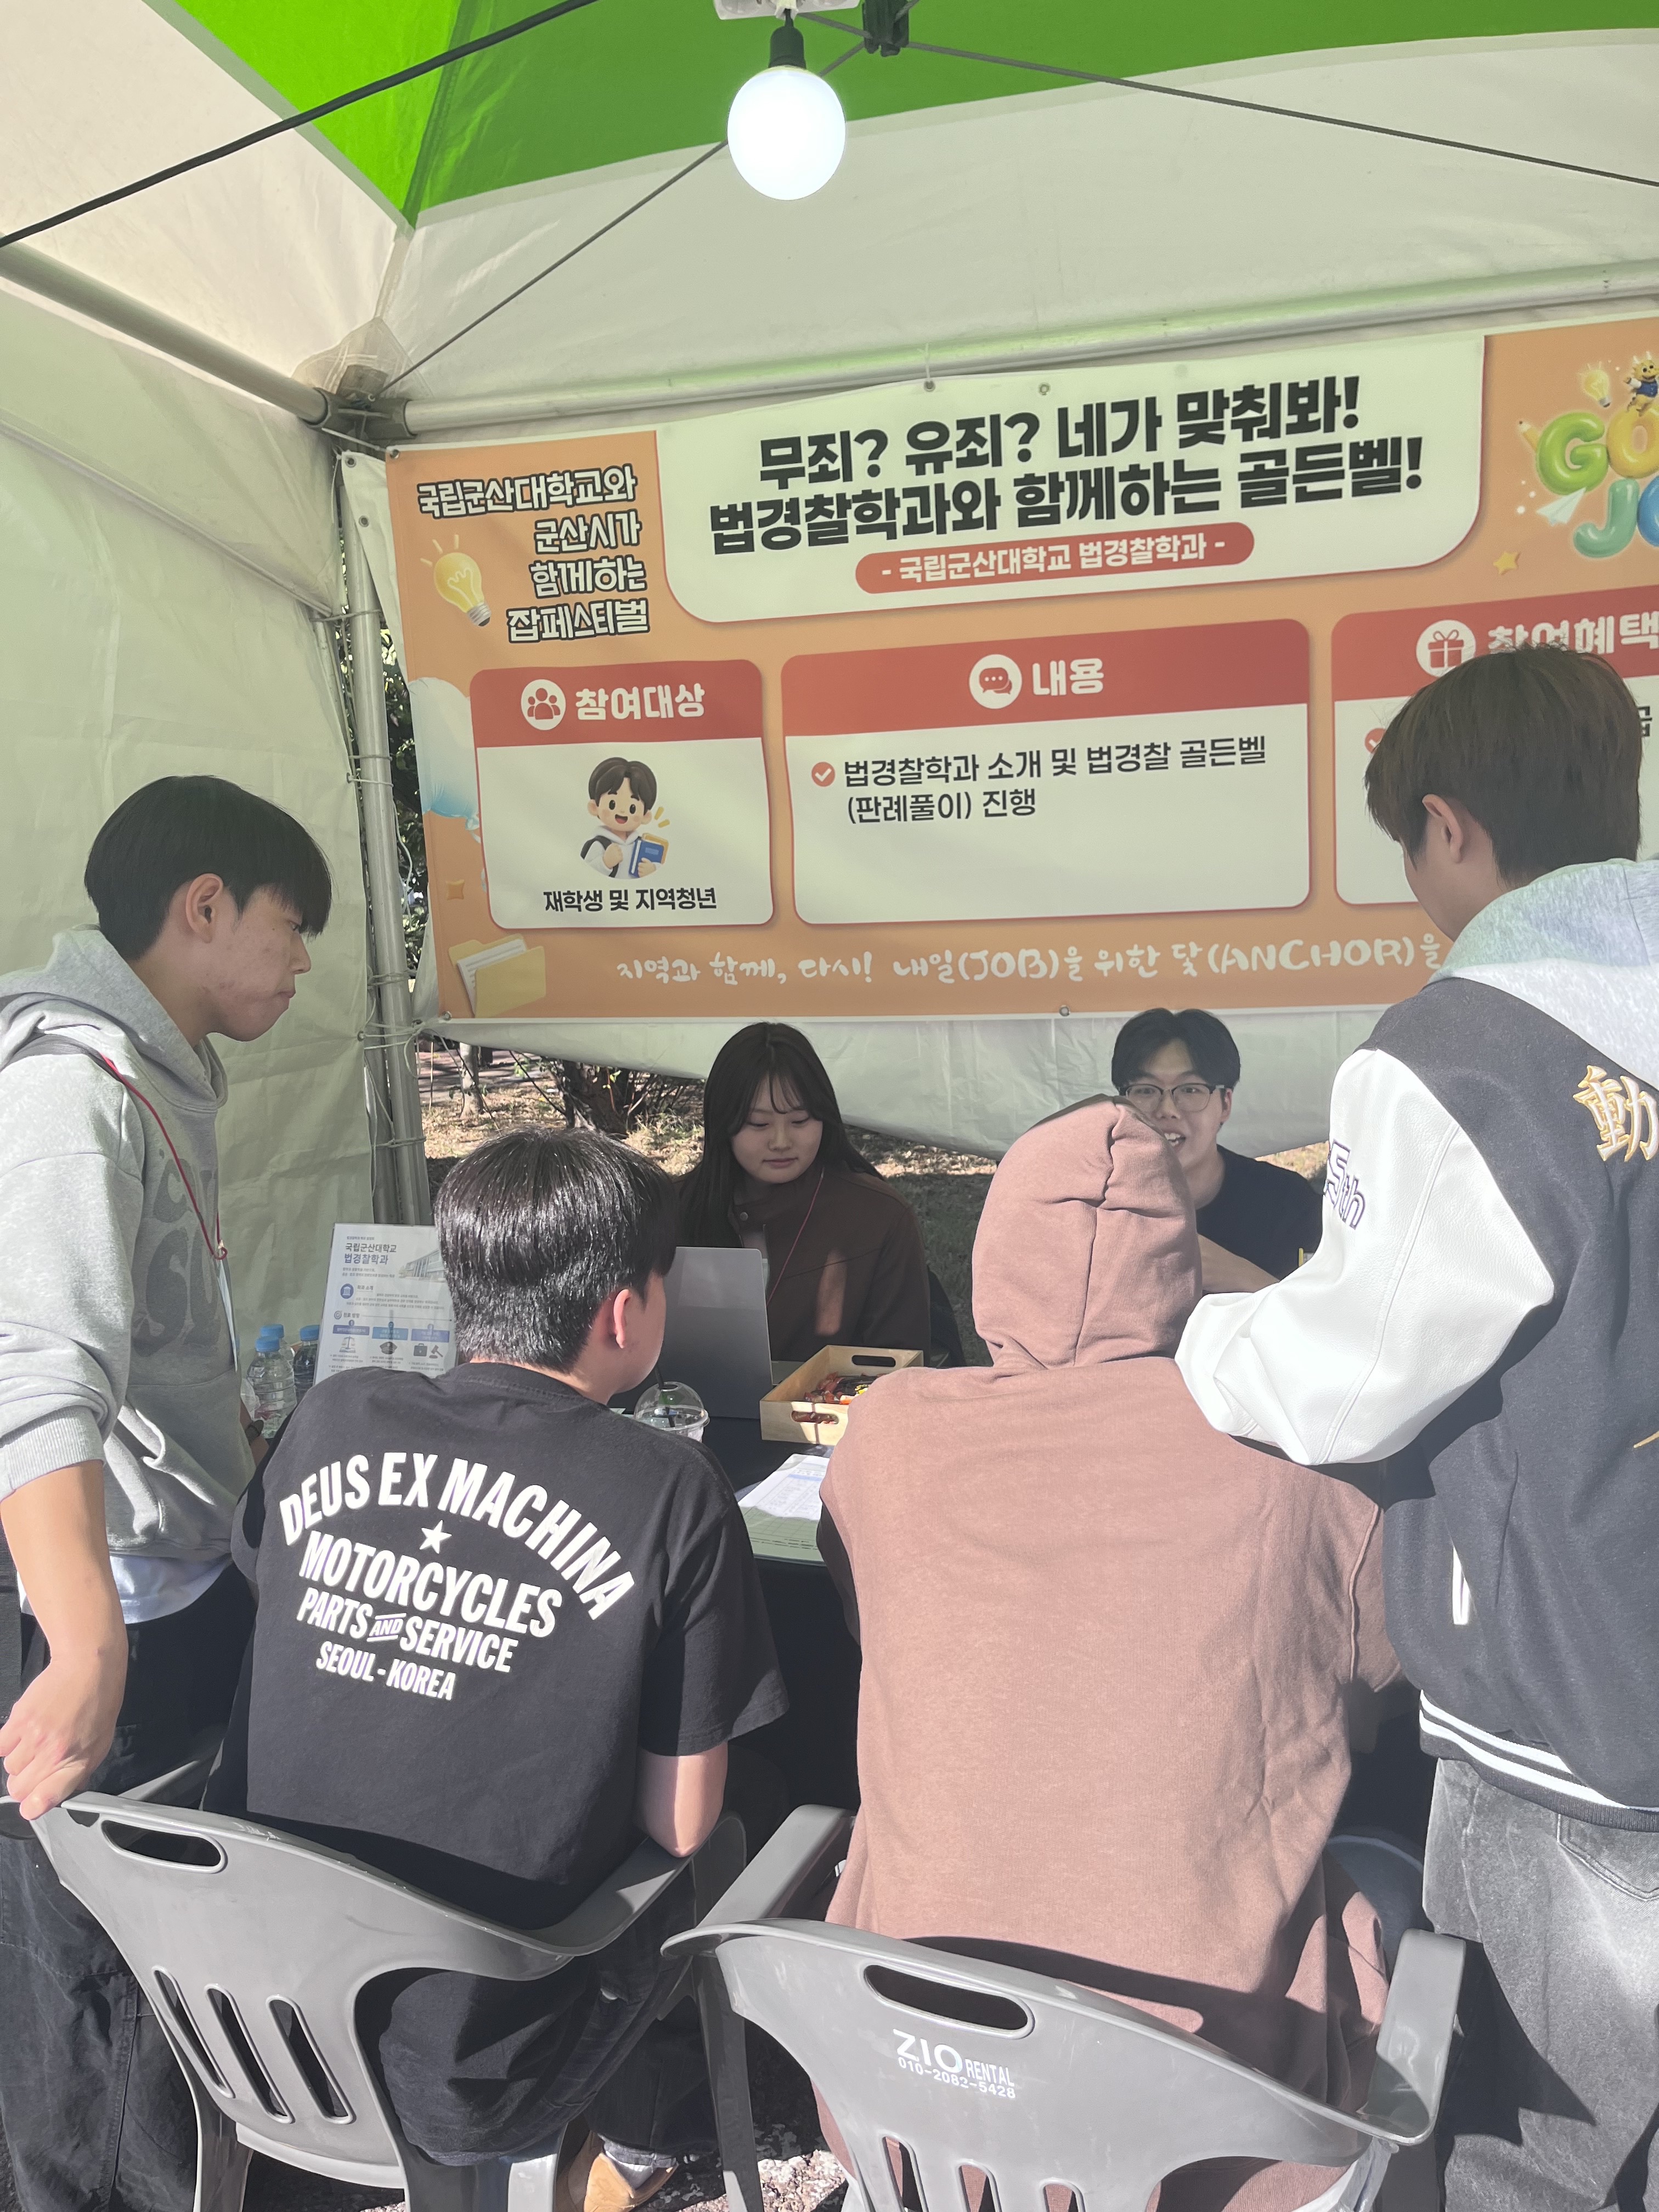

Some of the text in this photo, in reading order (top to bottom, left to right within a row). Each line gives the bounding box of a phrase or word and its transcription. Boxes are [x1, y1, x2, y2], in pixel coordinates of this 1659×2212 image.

[760, 375, 1359, 489] 무죄? 유죄? 네가 맞춰봐!
[417, 464, 637, 518] 국립군산대학교와
[710, 437, 1423, 555] 법경찰학과와 함께하는 골든벨!
[534, 510, 642, 554] 군산시가
[899, 543, 1071, 583] 국립군산대학교
[1079, 532, 1206, 569] 법경찰학과
[529, 555, 647, 599] 함께하는
[507, 598, 650, 643] 잡페스티벌
[575, 683, 706, 720] 참여대상
[1032, 658, 1104, 696] 내용
[844, 735, 1267, 787] 법경찰학과 소개 및 법경찰 골든벨
[847, 788, 1036, 824] (판례풀이) 진행
[543, 887, 717, 912] 재학생 및 지역청년
[617, 933, 1442, 985] 지역과 함께, 다시! 내일(JOB)을 위한 닻(ANCHOR)을
[1572, 1065, 1659, 1162] 動
[344, 1253, 388, 1265] 법경찰학과
[345, 1243, 397, 1253] 국립군산대학교
[279, 1452, 635, 1620] DEUS EX MACHINA
[299, 1531, 562, 1638] MOTORCYCLES
[296, 1587, 519, 1673] PARTS AND SERVICE
[316, 1641, 375, 1682] SEOUL
[386, 1658, 456, 1700] KOREA
[893, 2028, 1015, 2087] ZIO RENTAL
[898, 2057, 1015, 2098] 010-2082-5428
